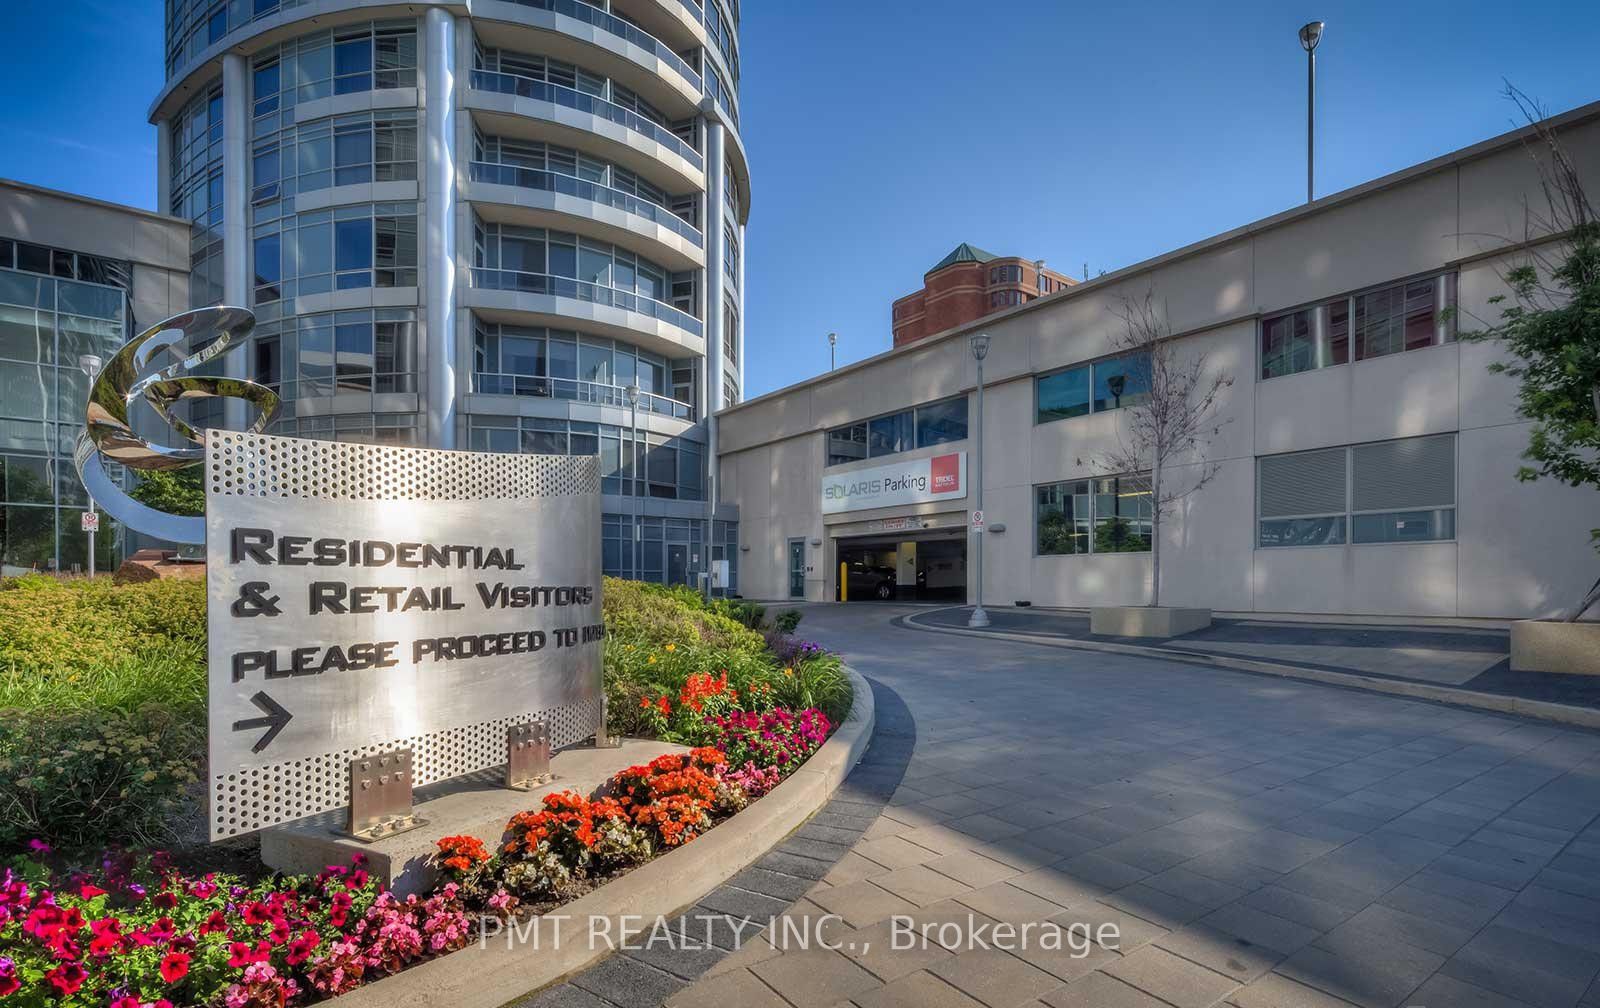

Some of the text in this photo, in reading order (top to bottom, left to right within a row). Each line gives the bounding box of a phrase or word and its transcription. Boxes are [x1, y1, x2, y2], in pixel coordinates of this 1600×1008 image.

[825, 480, 881, 500] SOLARIS
[884, 475, 926, 492] Parking
[231, 528, 525, 570] RESIDENTIAL
[231, 581, 592, 617] & RETAIL VISITORS
[231, 641, 399, 683] PLEASE
[412, 630, 546, 664] PROCEED
[552, 628, 578, 648] TO
